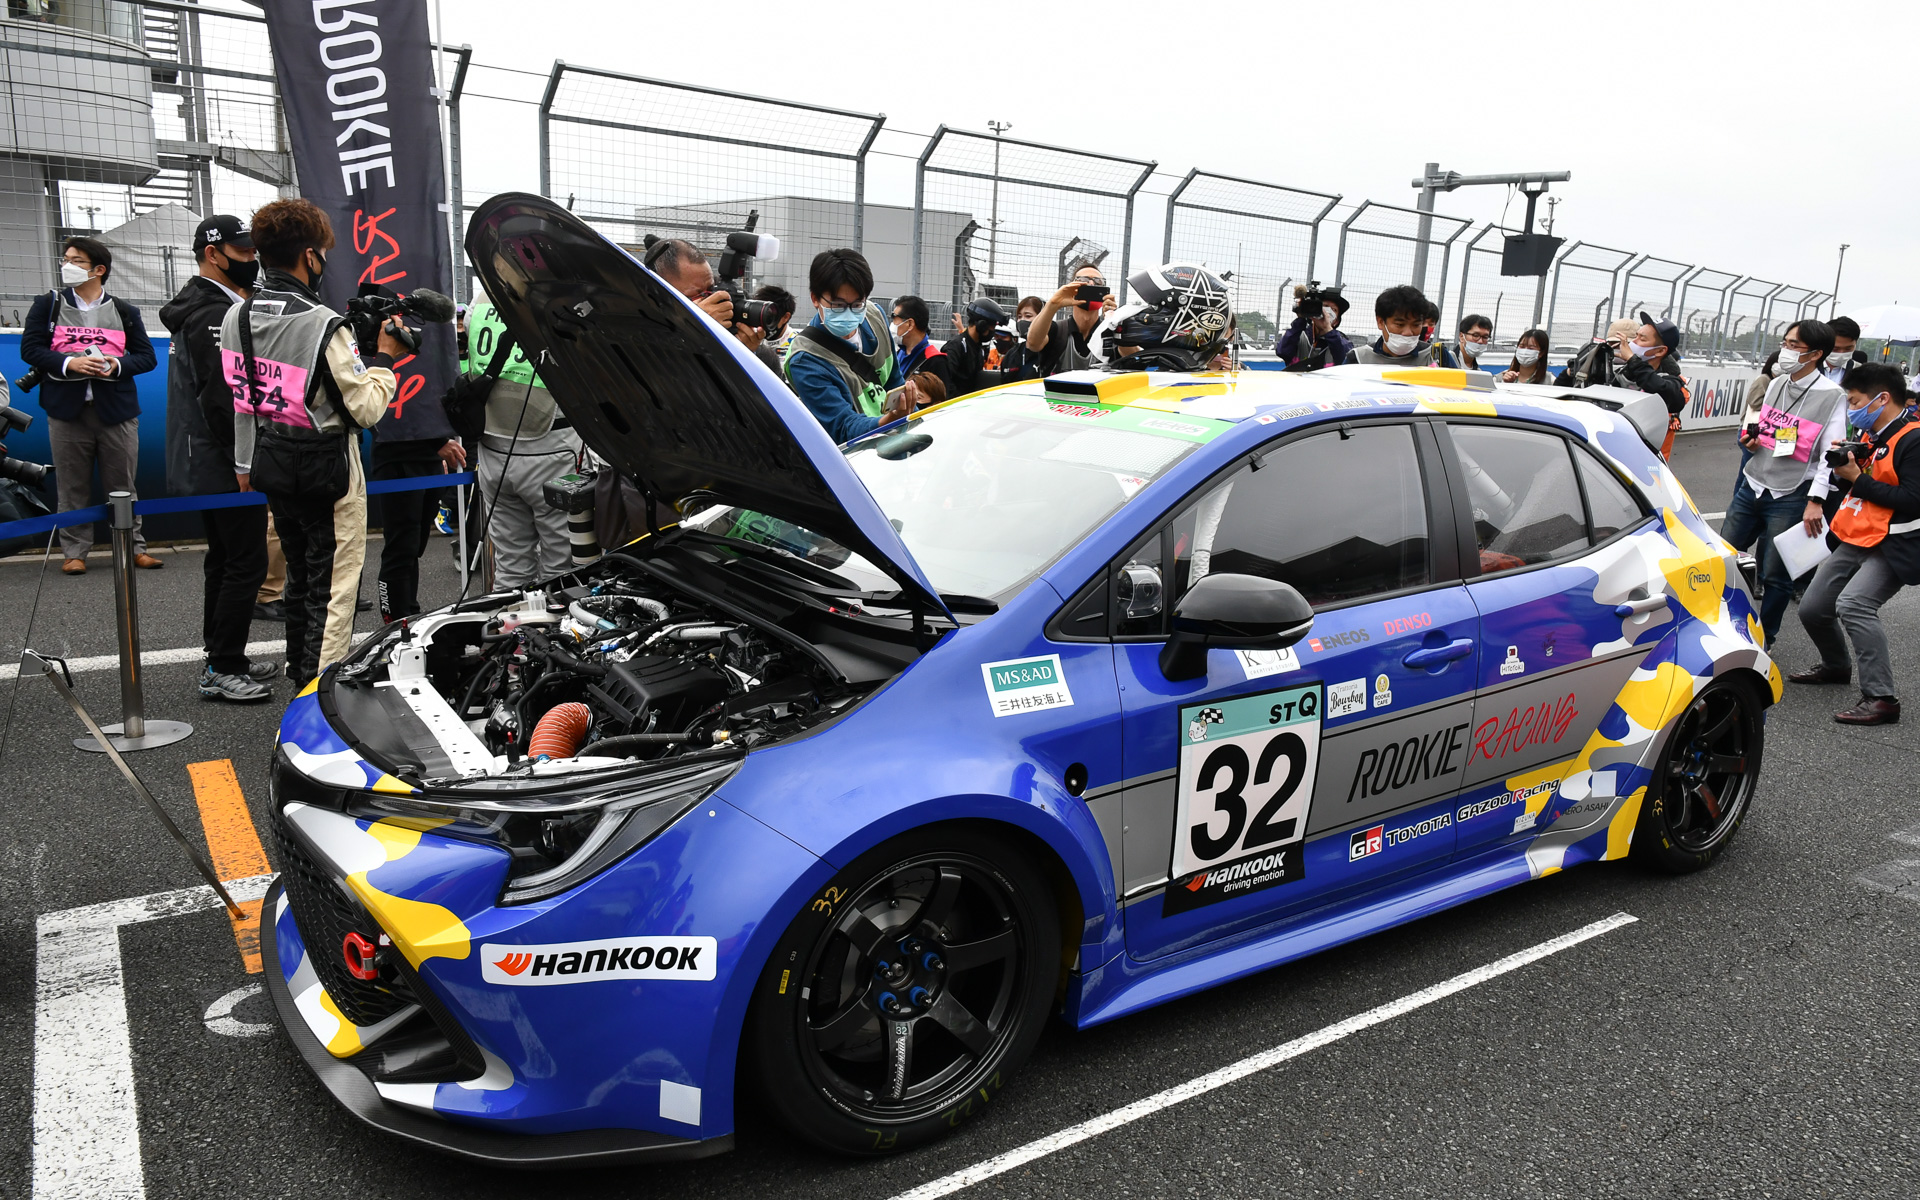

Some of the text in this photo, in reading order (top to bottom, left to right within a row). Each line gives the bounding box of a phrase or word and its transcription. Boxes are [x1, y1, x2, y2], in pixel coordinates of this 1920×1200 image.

[64, 334, 108, 346] 369
[67, 327, 104, 335] MEDIA
[1691, 379, 1732, 418] Mobil
[1693, 574, 1711, 583] NEDO
[1384, 612, 1432, 636] DENSO
[1320, 629, 1370, 649] ENEOS
[995, 667, 1052, 686] MS&AD
[998, 691, 1066, 712] 三井住友海上
[1375, 693, 1390, 701] ROOKIE
[1347, 693, 1578, 803] ROOKIE RACING
[1190, 732, 1307, 861] 32
[1351, 778, 1560, 859] GR TOYOTA GAZOO Racing
[1223, 869, 1285, 894] driving emotion
[812, 886, 849, 917] 32
[895, 1026, 908, 1035] 32
